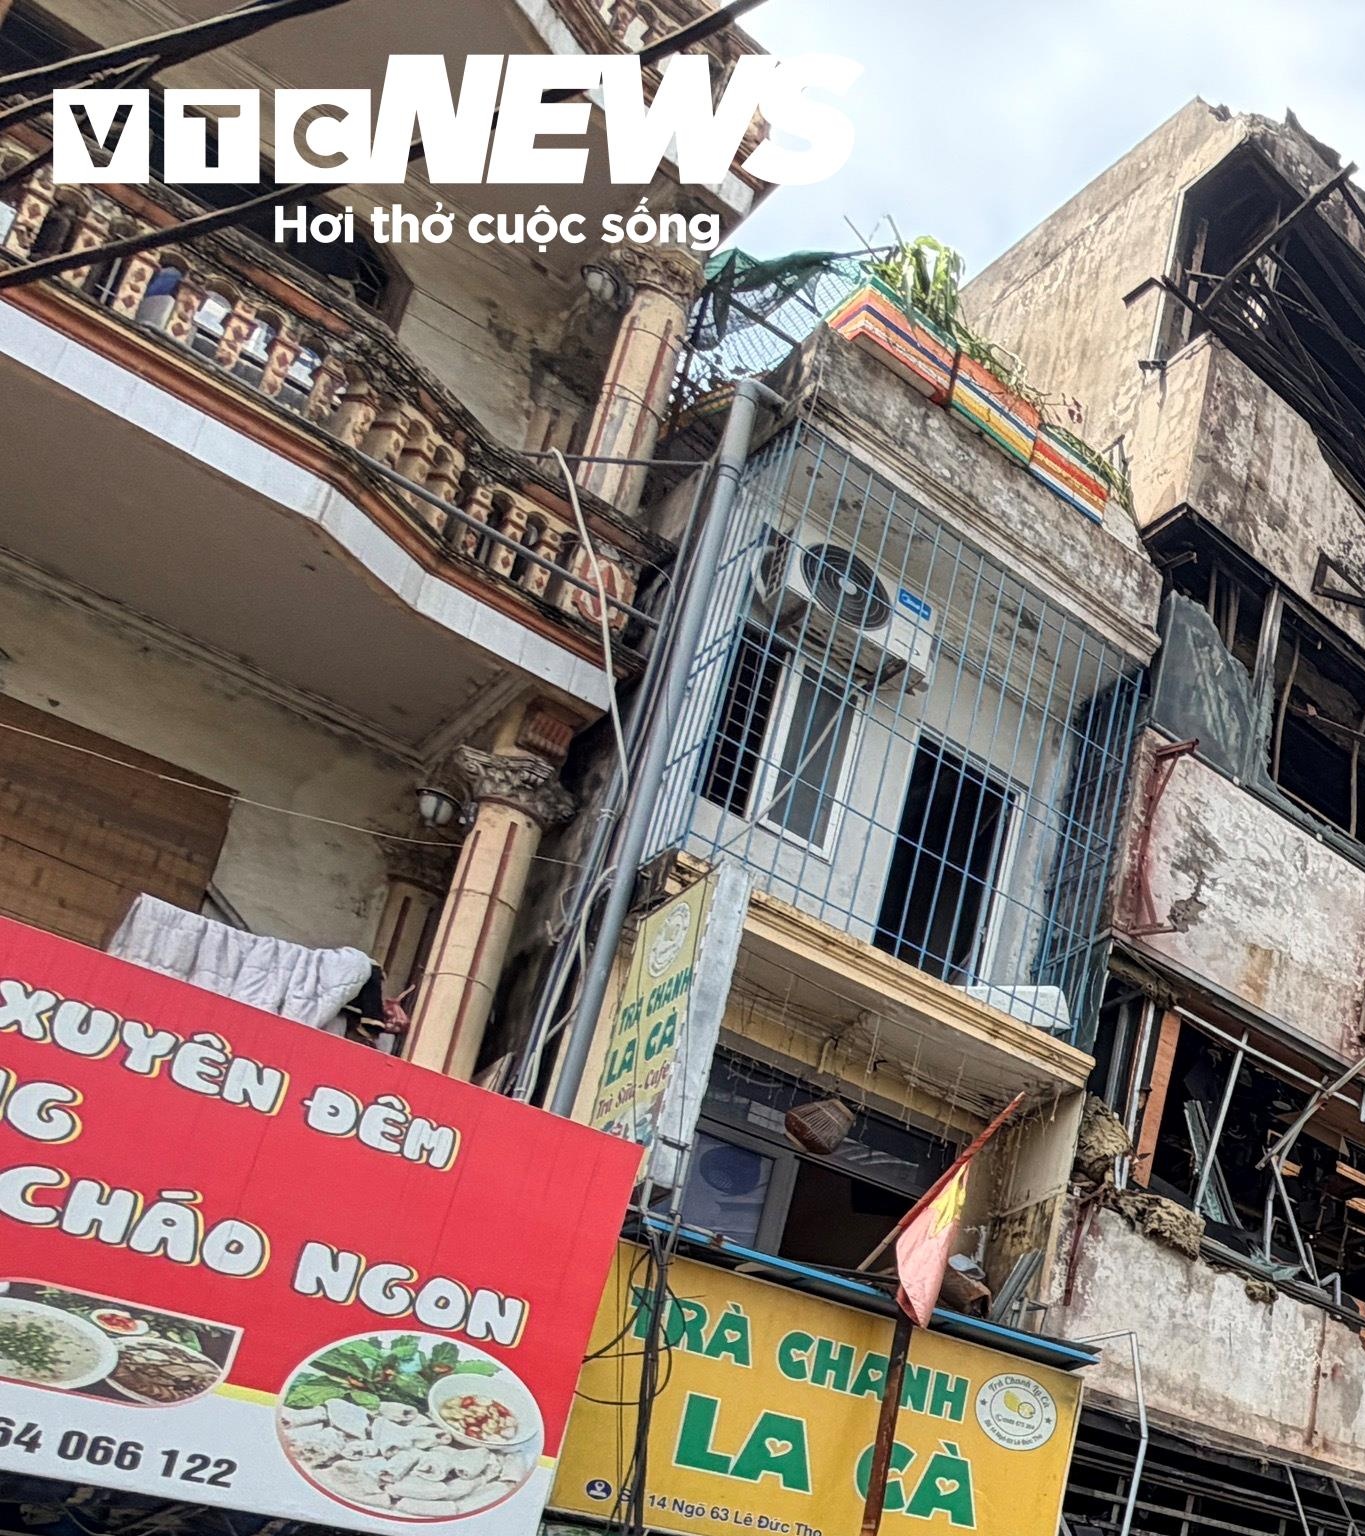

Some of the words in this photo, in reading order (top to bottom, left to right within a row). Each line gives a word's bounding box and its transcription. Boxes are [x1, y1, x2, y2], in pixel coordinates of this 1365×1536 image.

[0, 978, 289, 1115] XUYÊN
[301, 1086, 460, 1172] ĐÊM
[605, 1038, 637, 1086] LA
[644, 1007, 677, 1061] CÀ
[292, 1241, 529, 1347] NGON
[629, 1285, 752, 1369] TRÀ
[777, 1330, 971, 1424] CHANH
[57, 1430, 144, 1471] 066
[161, 1449, 237, 1488] 122
[671, 1391, 813, 1495] LA
[854, 1439, 977, 1530] CÀ
[672, 1498, 705, 1518] Ngõ
[710, 1506, 729, 1521] 63
[734, 1510, 753, 1527] Lê
[757, 1514, 790, 1534] Đức
